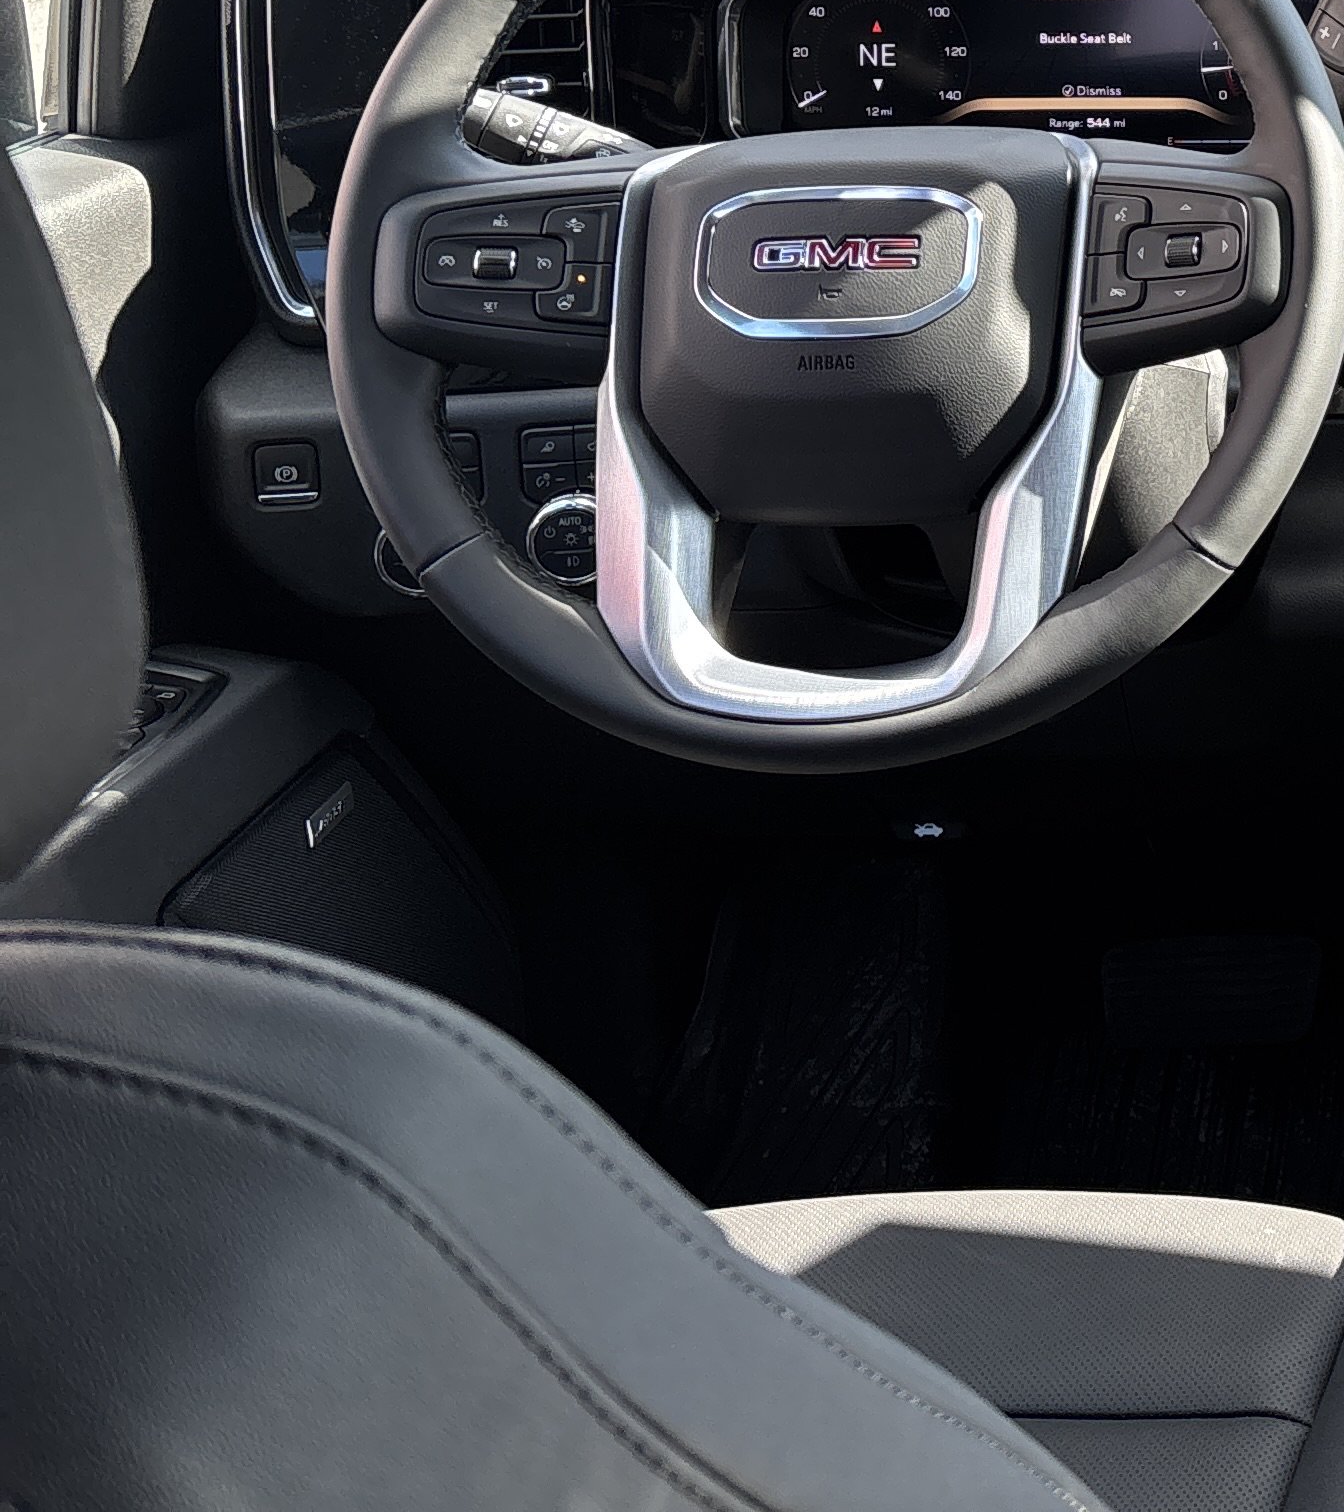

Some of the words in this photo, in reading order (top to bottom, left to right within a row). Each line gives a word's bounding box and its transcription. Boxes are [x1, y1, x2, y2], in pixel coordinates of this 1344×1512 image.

[809, 7, 825, 17] 40
[928, 7, 950, 17] 100
[1039, 32, 1077, 44] Buckle
[1080, 33, 1105, 44] Seat
[1108, 32, 1131, 44] Belt
[792, 47, 809, 57] 20
[859, 43, 897, 67] NE
[944, 46, 967, 57] 120
[939, 90, 962, 100] 140
[1077, 85, 1121, 96] Dismiss
[1218, 90, 1228, 100] 0
[866, 107, 879, 116] 12
[881, 106, 893, 116] mi
[1049, 118, 1084, 130] Range:
[1086, 117, 1111, 128] 544
[1113, 118, 1126, 128] mi
[752, 235, 921, 272] GMC
[483, 301, 498, 310] SET
[798, 355, 855, 371] AIRBAG
[559, 516, 582, 526] AUTO
